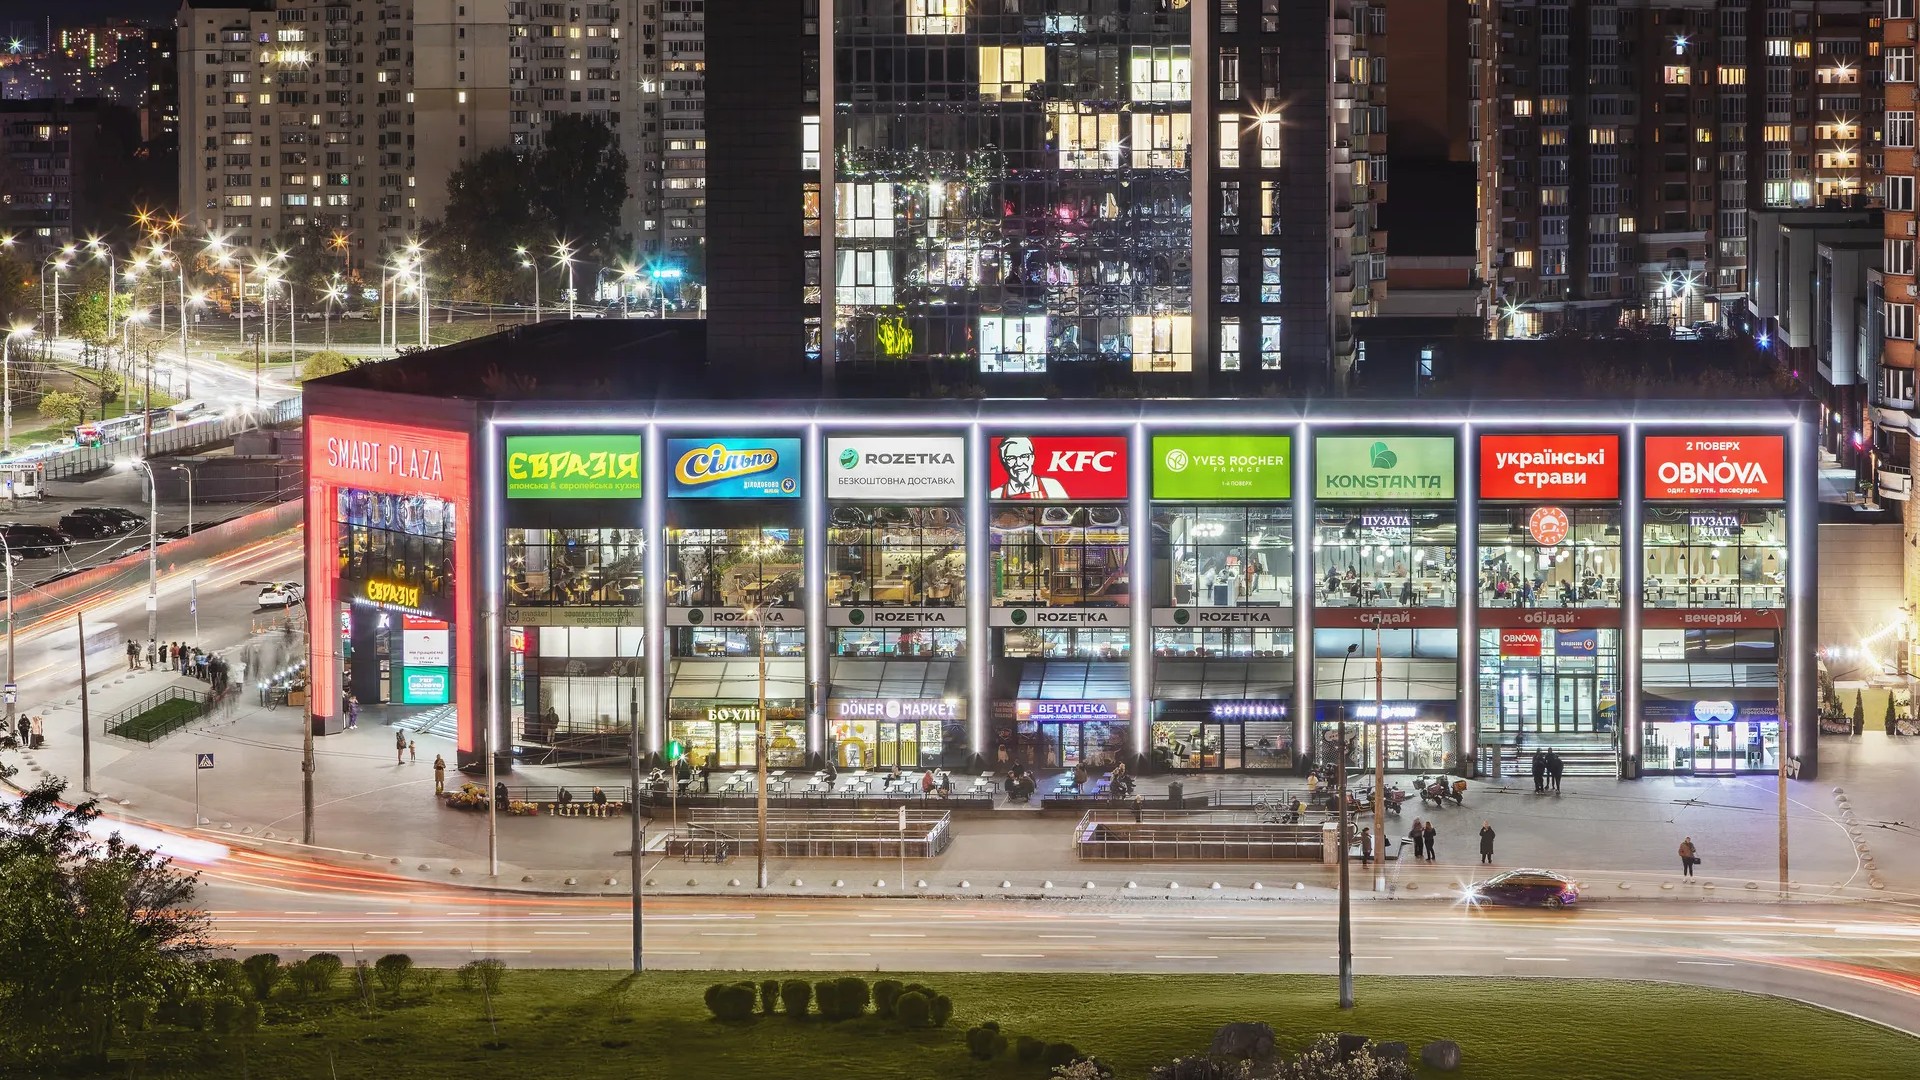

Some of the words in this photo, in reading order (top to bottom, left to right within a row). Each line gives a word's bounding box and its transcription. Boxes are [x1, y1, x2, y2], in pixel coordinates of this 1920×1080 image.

[1686, 442, 1693, 450] 2
[1696, 442, 1740, 450] ПОВЕРХ
[328, 437, 381, 473] SMART
[389, 444, 444, 482] PLAZA
[685, 449, 774, 479] Сільпо
[865, 453, 955, 465] ROZETKA
[1047, 450, 1115, 473] KFC
[1193, 455, 1225, 466] YVES
[1229, 455, 1284, 466] ROCHER
[1496, 448, 1605, 469] українські
[509, 451, 640, 480] ЄВРАЗІЯ
[509, 482, 549, 490] японська
[551, 481, 557, 490] &
[559, 481, 613, 491] європейська
[615, 483, 640, 491] кухня
[838, 477, 905, 485] БЕЗКОШТОВНА
[907, 477, 955, 486] ДОСТАВКА
[1326, 475, 1441, 489] KONSTANTA
[1514, 472, 1587, 489] страви
[1362, 516, 1410, 526] ПУЗАТА
[1690, 516, 1739, 526] ПУЗАТА
[1371, 526, 1402, 536] ХАТА
[1699, 527, 1731, 537] ХАТА
[368, 580, 418, 607] ЄВРАЗІЯ
[875, 612, 945, 622] ROZETKA
[1037, 612, 1108, 622] ROZETKA
[1200, 612, 1271, 622] ROZETKA
[1524, 611, 1574, 625] обідай
[1685, 611, 1742, 625] вечеряй
[841, 700, 884, 715] DÖNER
[1039, 704, 1107, 713] ВЕТАПТЕКА
